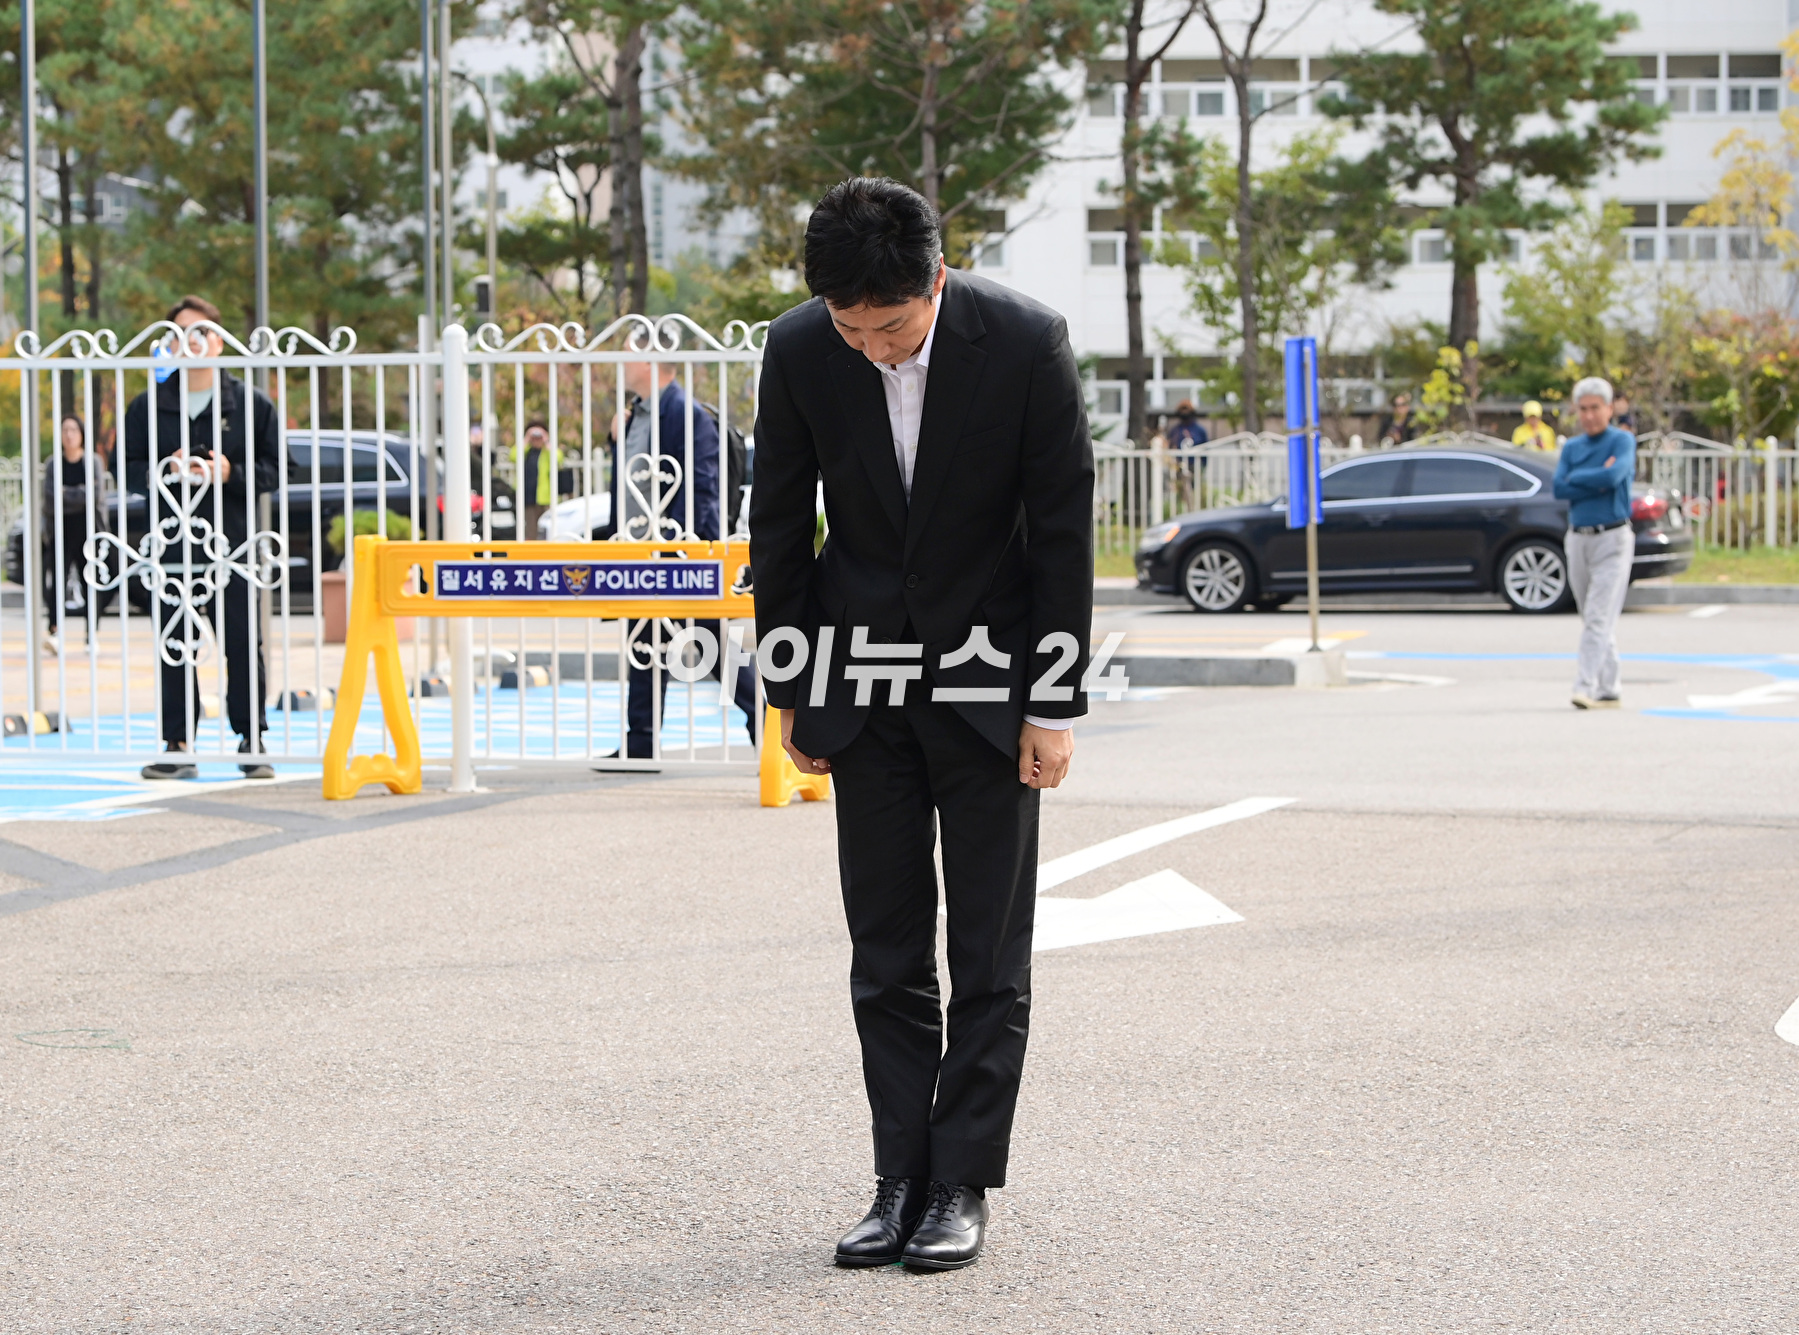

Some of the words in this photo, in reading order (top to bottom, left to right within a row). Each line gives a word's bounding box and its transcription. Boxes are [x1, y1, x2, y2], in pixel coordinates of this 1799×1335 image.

[441, 569, 559, 592] 질서유지선
[595, 569, 667, 590] POLICE
[673, 569, 715, 590] LINE
